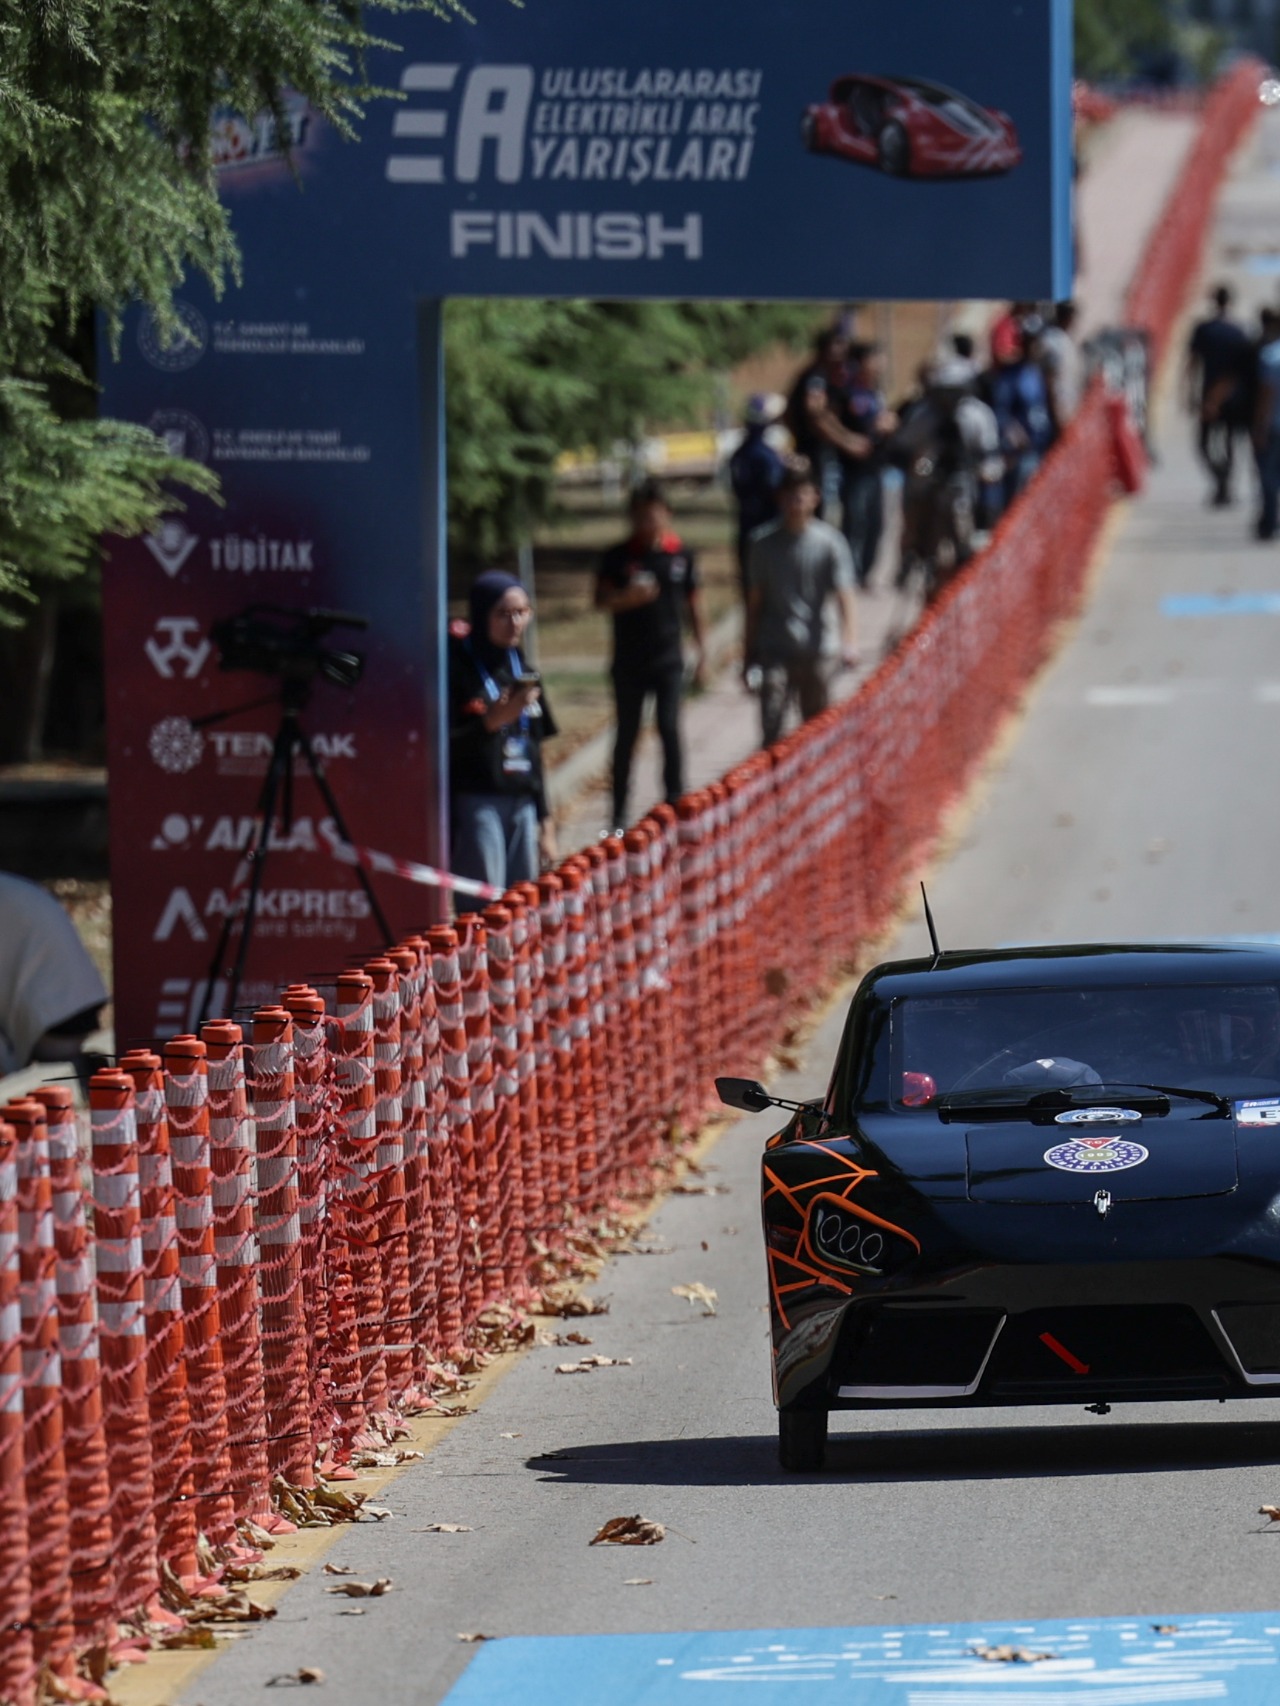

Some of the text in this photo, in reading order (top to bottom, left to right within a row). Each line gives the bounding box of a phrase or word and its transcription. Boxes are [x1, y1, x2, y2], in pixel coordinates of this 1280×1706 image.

[541, 68, 763, 98] ULUSLARARASI
[533, 100, 760, 137] ELEKTRİKLİ ARAÇ
[450, 212, 702, 259] FINISH
[209, 533, 314, 572] TÜBİTAK
[208, 732, 357, 758] TENAK
[205, 887, 371, 918] AKPRES
